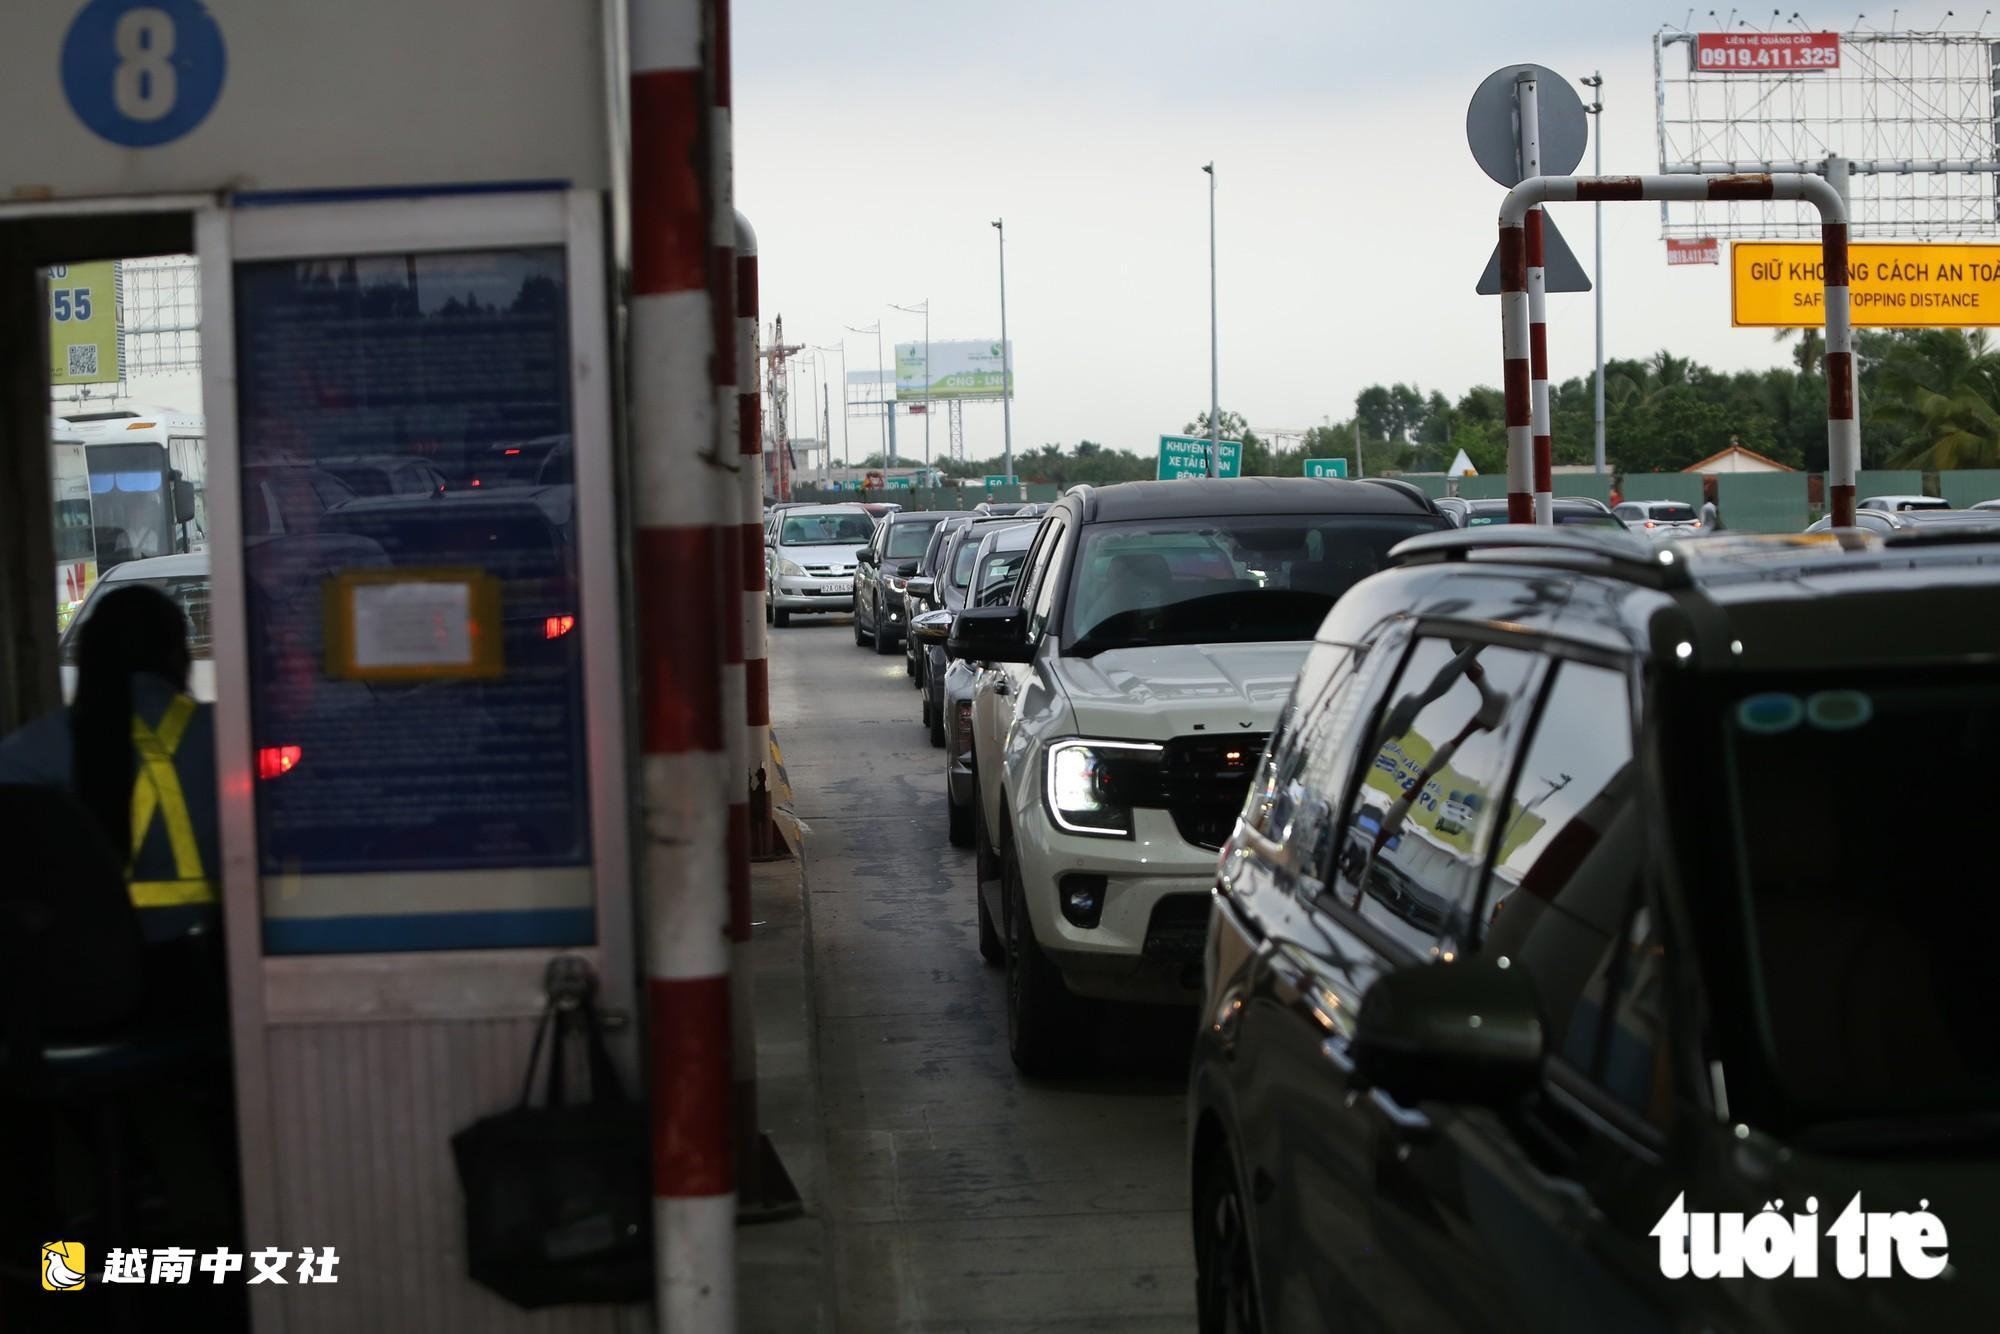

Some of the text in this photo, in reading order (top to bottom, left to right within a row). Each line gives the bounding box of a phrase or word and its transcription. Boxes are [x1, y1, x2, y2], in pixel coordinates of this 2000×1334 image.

[113, 6, 178, 121] 8
[1701, 47, 1837, 66] 0919.411.325
[1751, 258, 1783, 281] GIỮ
[1789, 263, 1869, 281] KHONG
[1877, 258, 1929, 281] CÁCH
[1936, 263, 1963, 281] AN
[49, 288, 92, 321] 55
[1794, 292, 1980, 307] SAF TOPPING DISTANCE
[946, 375, 975, 387] CNG
[984, 375, 1005, 386] LN
[1206, 443, 1235, 457] KÍCH
[1169, 455, 1181, 467] XE
[1183, 454, 1198, 468] TẢI
[1315, 464, 1337, 478] 0 m
